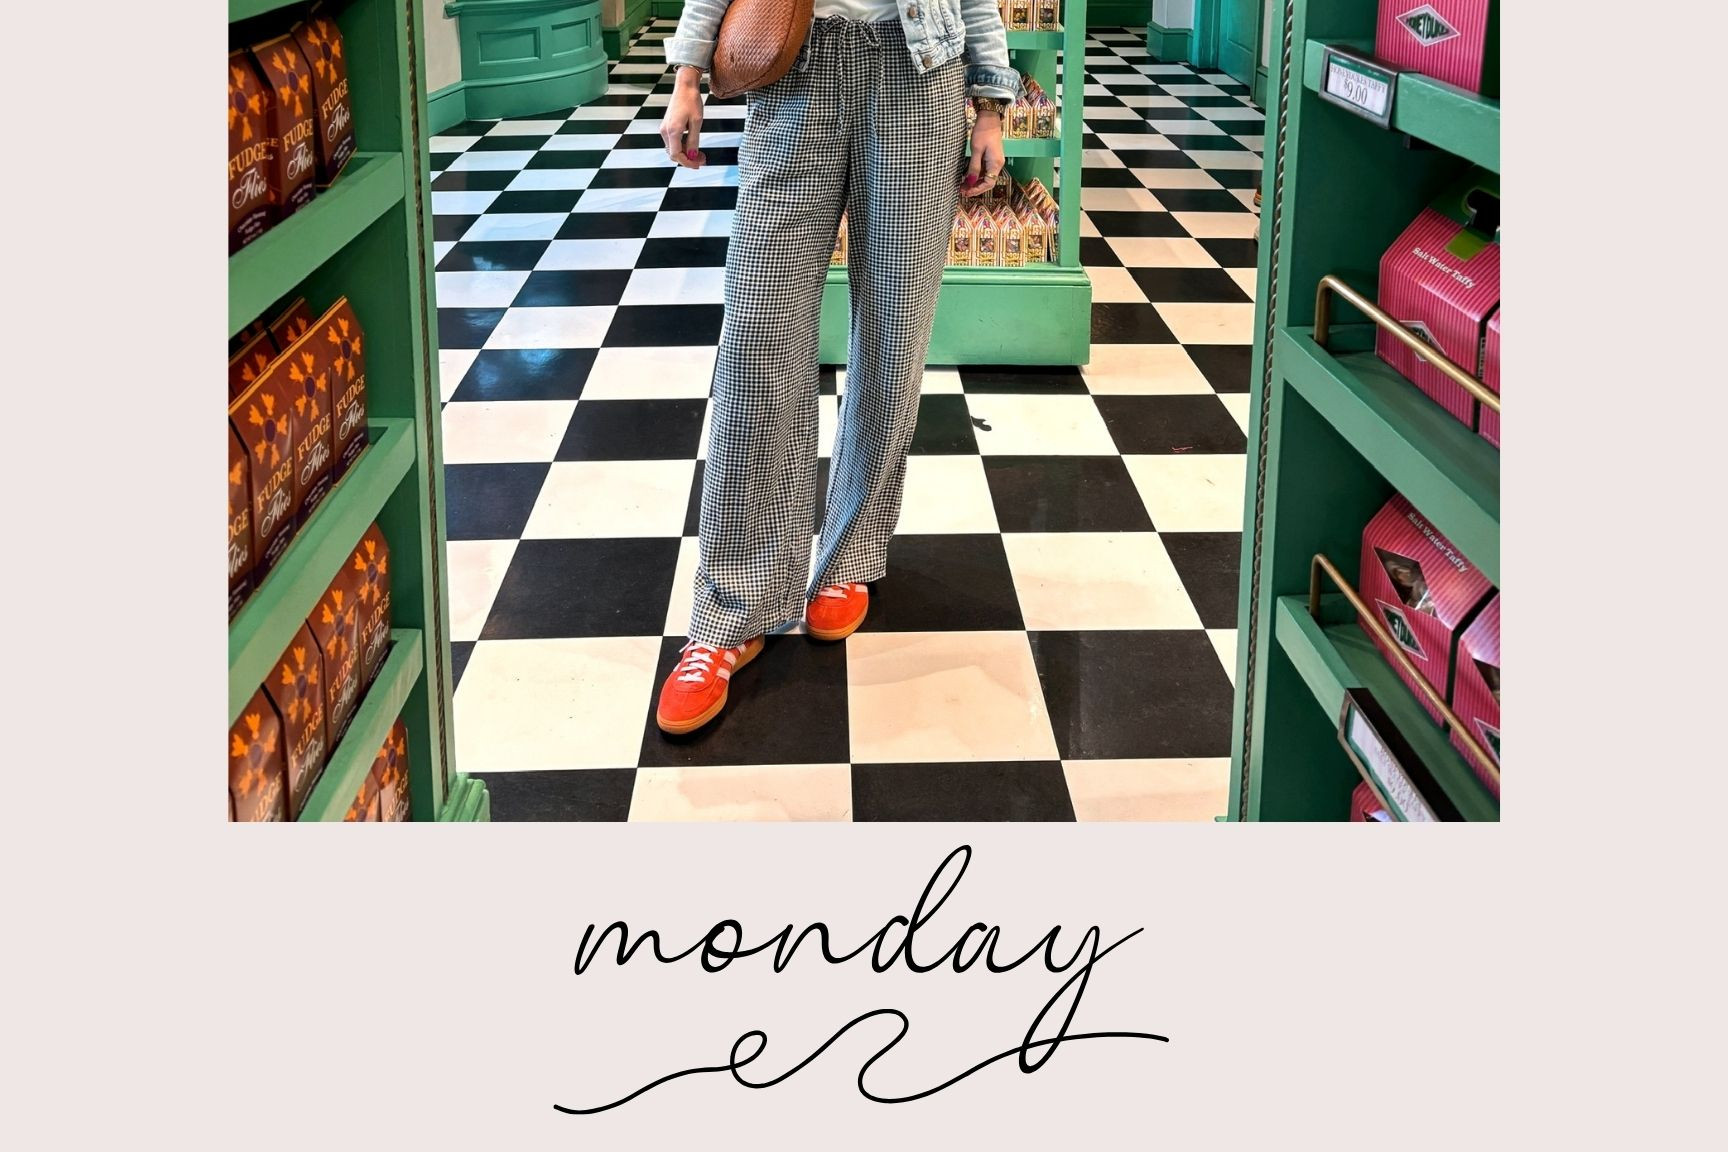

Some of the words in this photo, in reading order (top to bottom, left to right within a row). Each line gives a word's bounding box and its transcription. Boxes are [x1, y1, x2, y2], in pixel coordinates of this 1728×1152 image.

[322, 78, 349, 120] FUDGE
[283, 118, 314, 153] FUDGE
[228, 142, 267, 181] FUDGE
[232, 167, 267, 209] Flies
[1412, 247, 1430, 260] Salt
[1429, 255, 1453, 274] Water
[1451, 269, 1476, 289] Taffy
[336, 374, 366, 419] FUDGE
[297, 412, 331, 463] FUDGE
[257, 456, 293, 515] FUDGE
[261, 487, 292, 538] Flies
[1408, 512, 1424, 529] Salt
[1423, 526, 1447, 551] Water
[1445, 547, 1468, 573] Taffy
[362, 591, 391, 646] FUDGE
[329, 643, 359, 705] FUDGE
